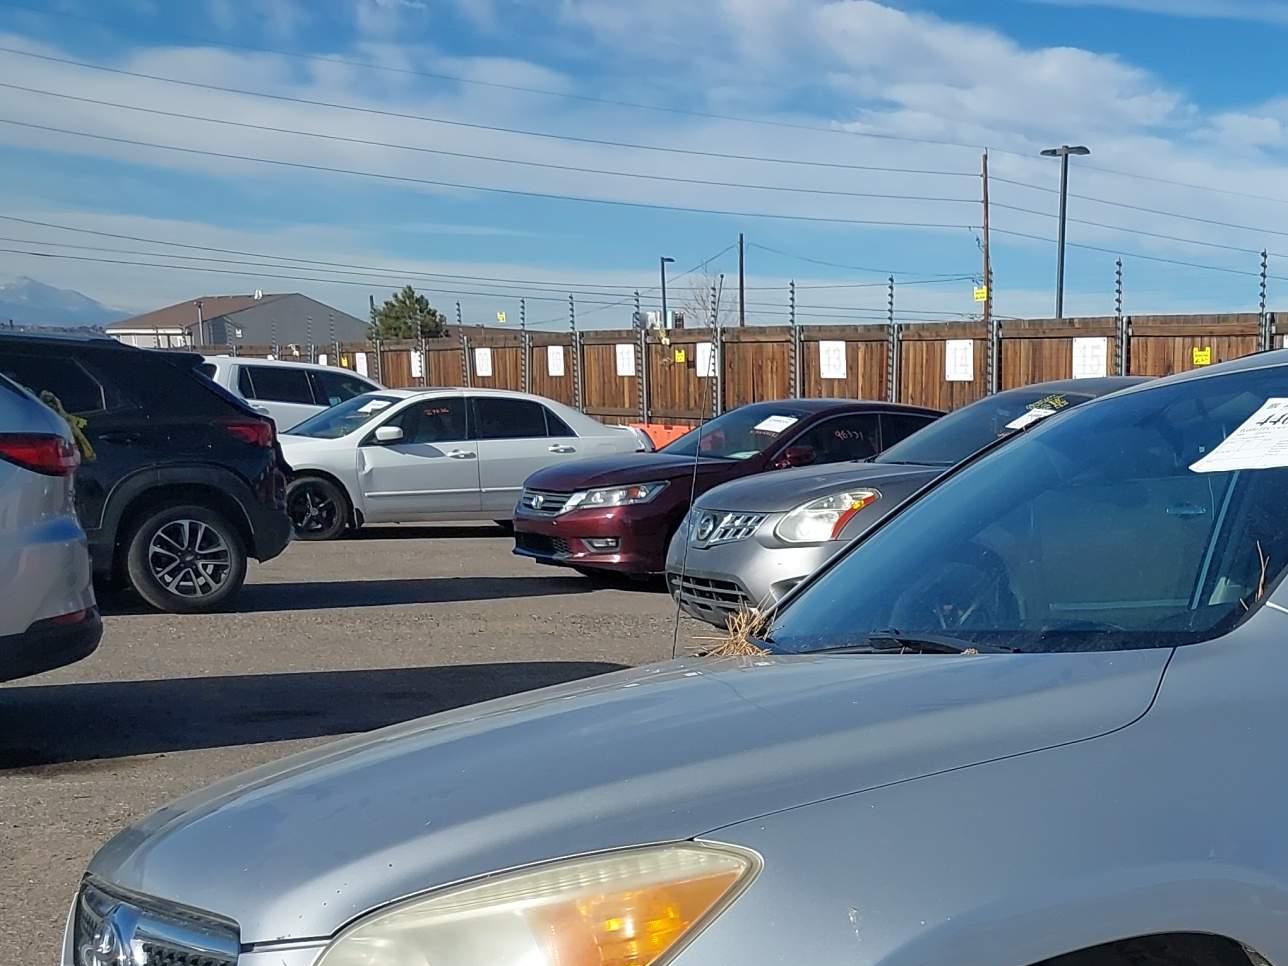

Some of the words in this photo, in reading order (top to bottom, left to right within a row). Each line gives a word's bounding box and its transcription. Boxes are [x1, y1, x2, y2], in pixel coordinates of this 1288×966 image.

[824, 346, 842, 373] 13
[952, 346, 969, 374] 14
[1081, 344, 1101, 375] 15
